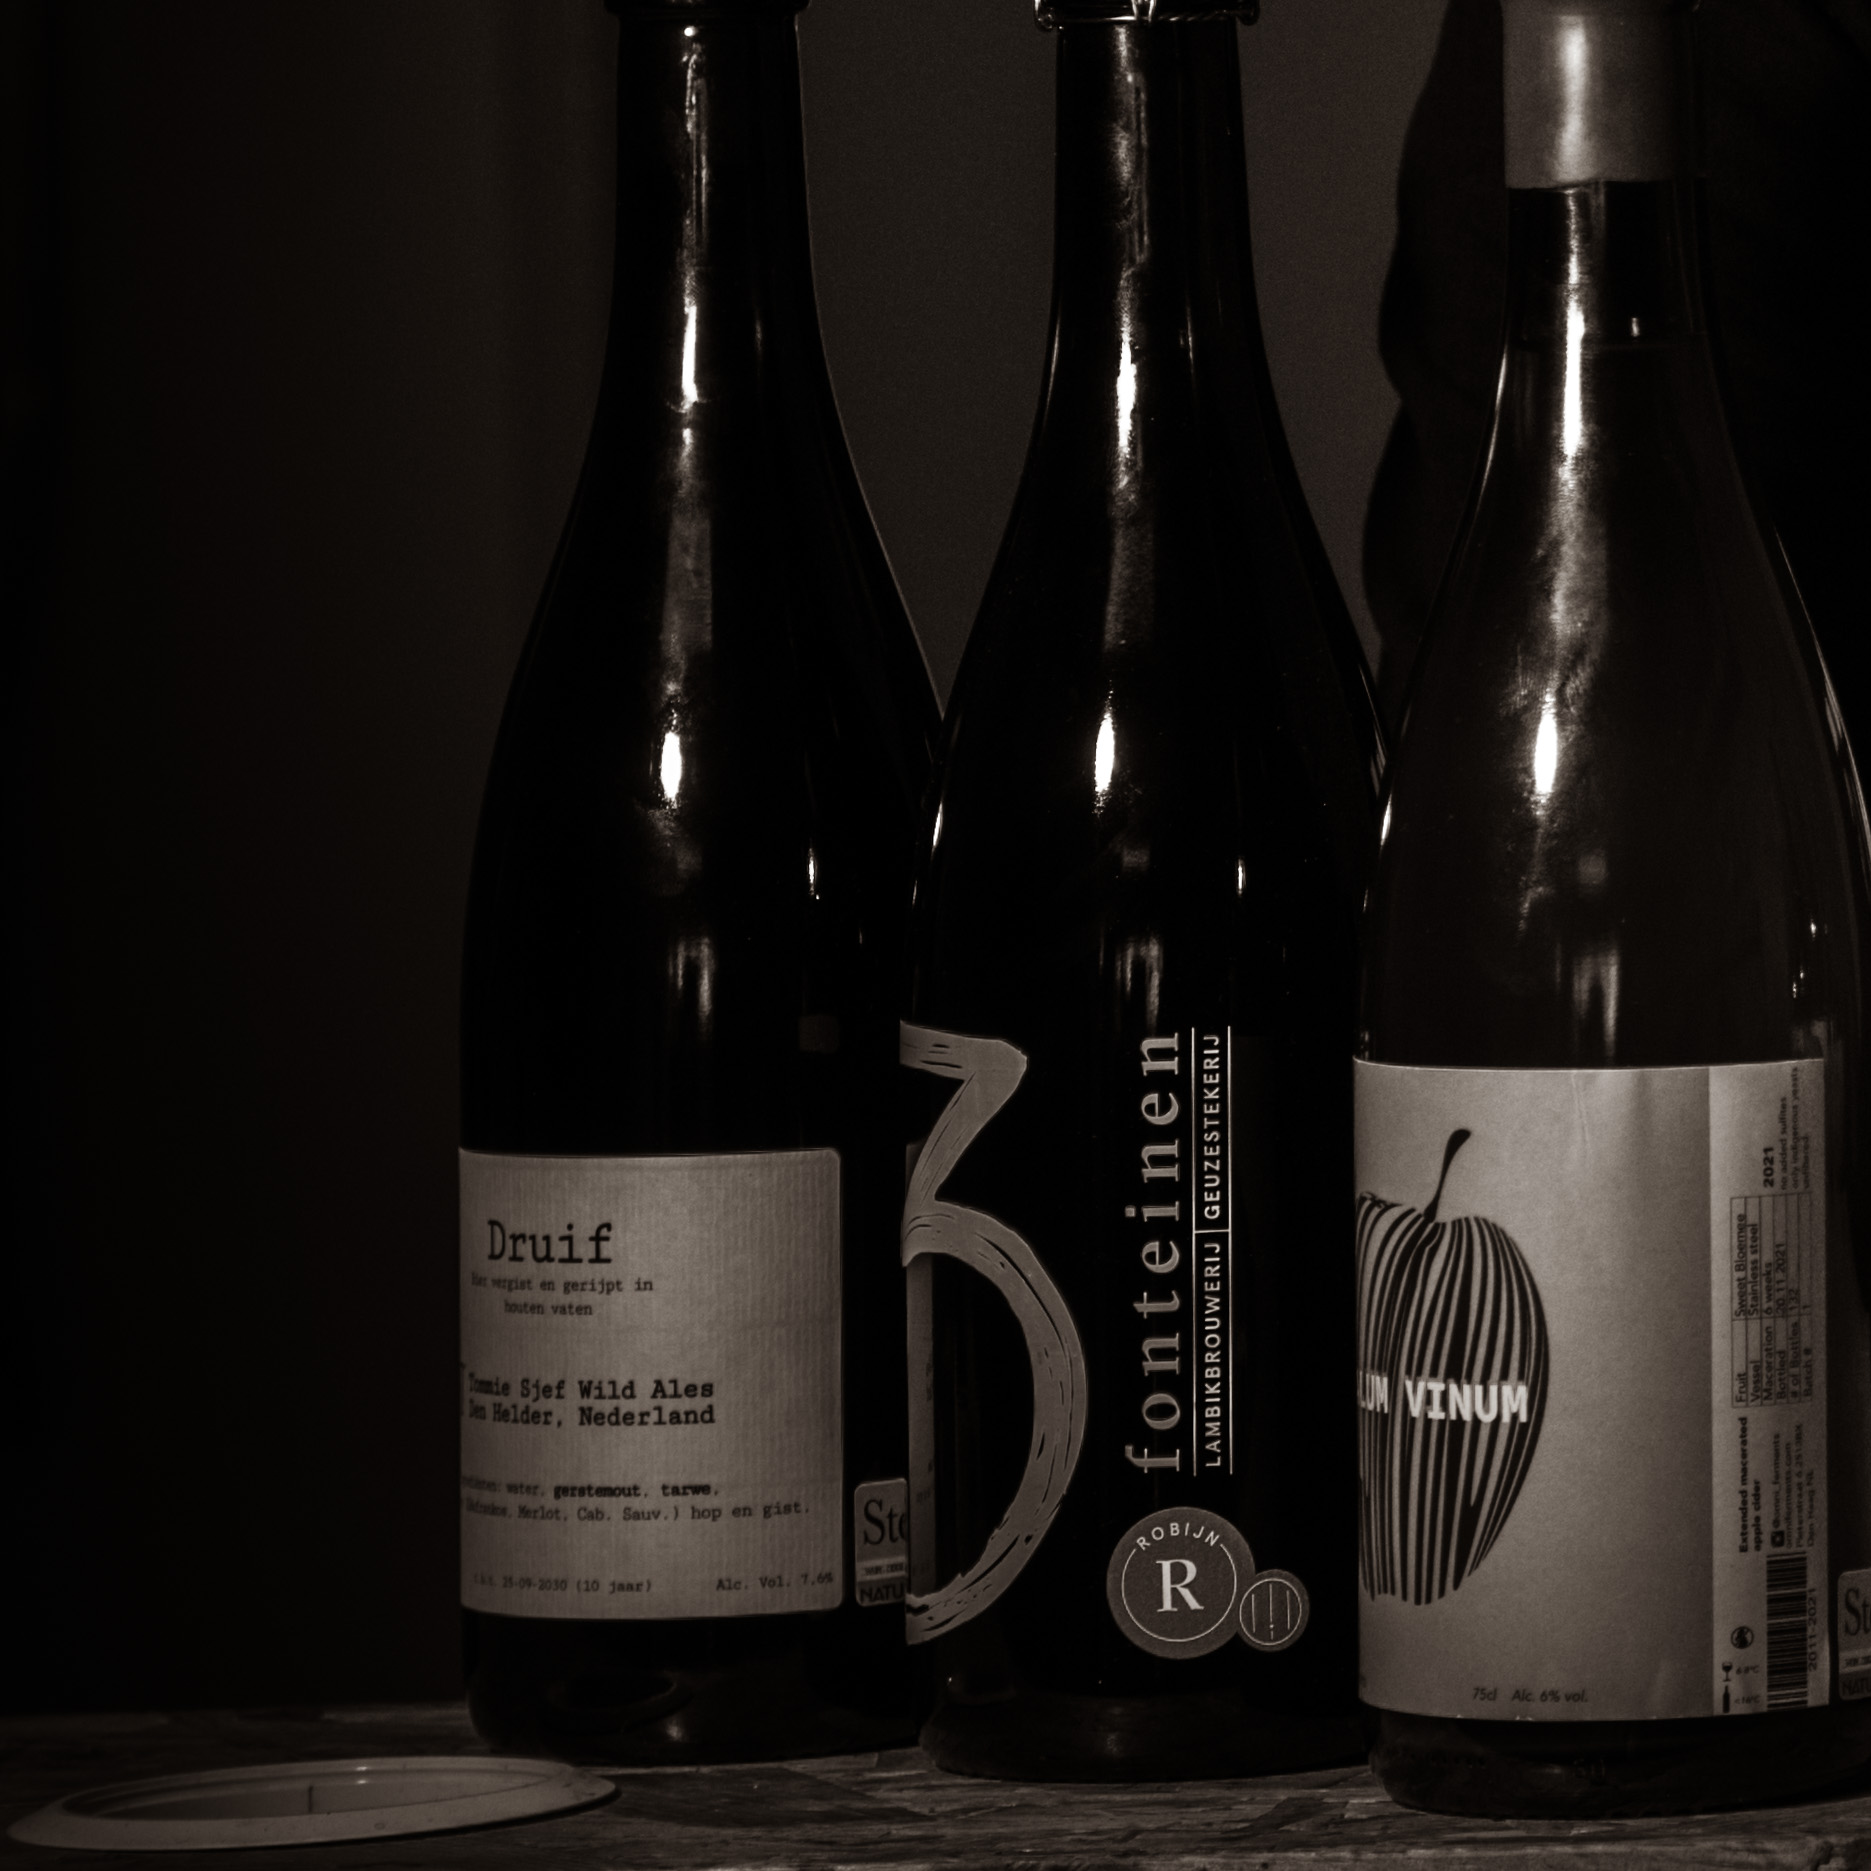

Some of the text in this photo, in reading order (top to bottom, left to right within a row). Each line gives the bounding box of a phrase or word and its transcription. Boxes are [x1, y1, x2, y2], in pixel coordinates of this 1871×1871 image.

[1762, 1146, 1775, 1188] 2021
[487, 1218, 613, 1265] Druif
[1125, 1030, 1182, 1474] fonteinen
[1202, 1032, 1223, 1469] LAMBIKBROUWERIJ GEUZESTEKERIJ
[539, 1278, 556, 1292] en
[562, 1277, 624, 1296] gerijpt
[634, 1276, 654, 1292] in
[1746, 1222, 1759, 1317] Stainless steel
[1762, 1262, 1773, 1304] weeks
[503, 1299, 593, 1316] houten vaten
[1734, 1276, 1747, 1317] Sweet
[1749, 1360, 1761, 1403] Vessel
[1763, 1326, 1775, 1401] Maceration
[1775, 1350, 1787, 1400] Bottled
[520, 1377, 566, 1403] Sjef
[577, 1378, 638, 1400] Wild
[650, 1378, 715, 1400] Ales
[1404, 1379, 1529, 1425] VINUM
[1735, 1372, 1747, 1403] Fruit
[492, 1402, 563, 1429] Helder,
[577, 1403, 717, 1427] Nederland
[1737, 1416, 1750, 1554] Extended macerated
[576, 1505, 612, 1522] Cab.
[691, 1504, 723, 1523] hop
[731, 1505, 753, 1519] en
[1751, 1479, 1763, 1552] apple cider
[1136, 1521, 1221, 1552] ROBIJN
[576, 1578, 600, 1594] (10
[609, 1578, 652, 1595] jaar)
[715, 1577, 749, 1592] Alc.
[758, 1575, 791, 1590] Vol.
[1154, 1557, 1206, 1614] R
[1472, 1687, 1589, 1703] 75cl Alc. 6% vol.
